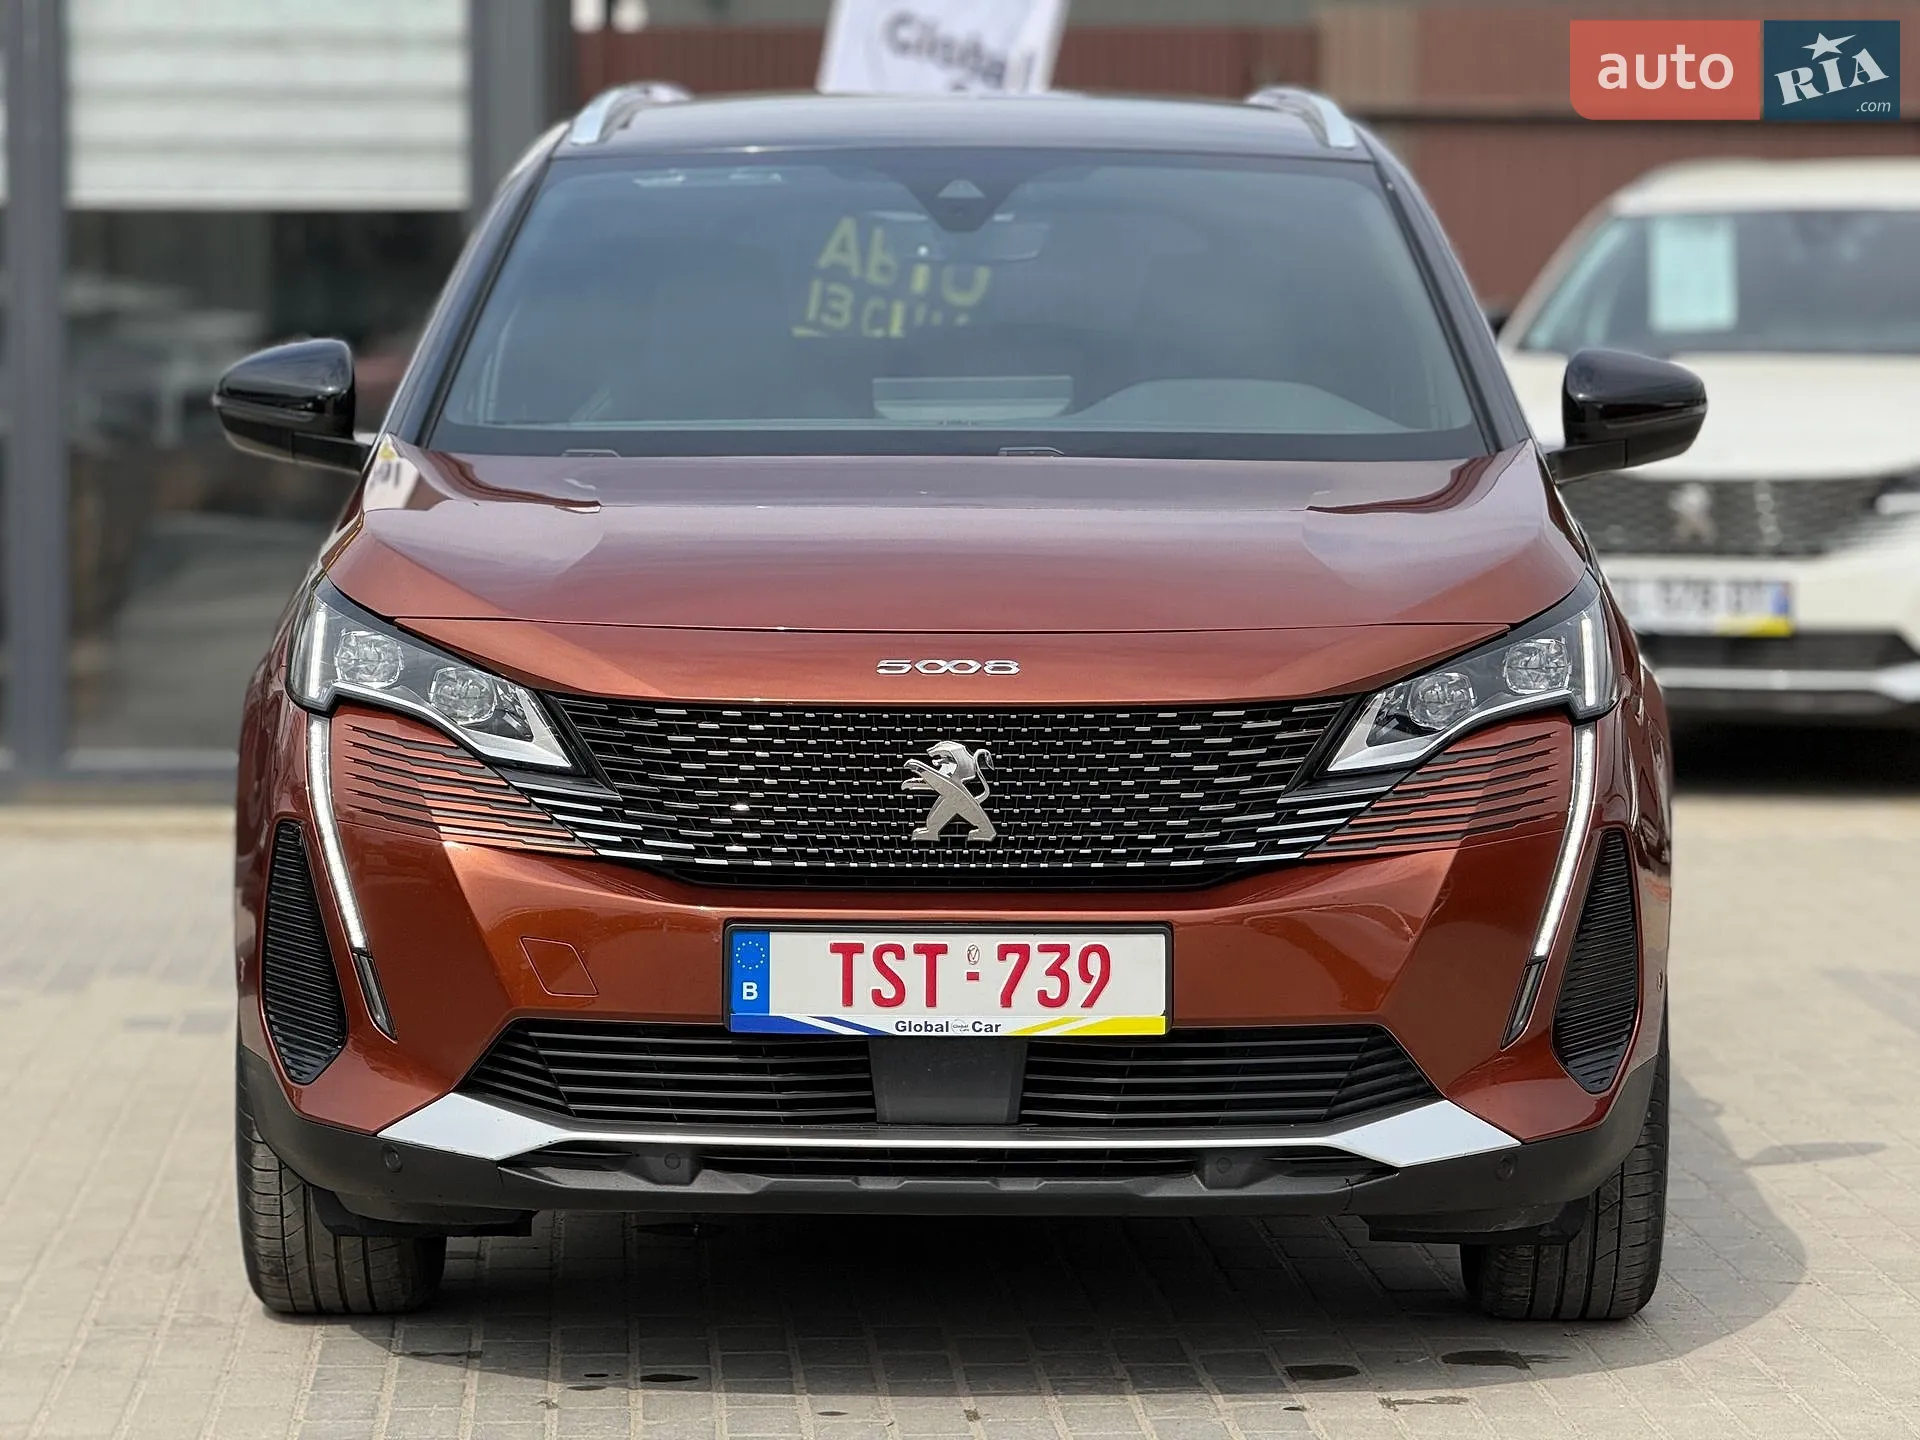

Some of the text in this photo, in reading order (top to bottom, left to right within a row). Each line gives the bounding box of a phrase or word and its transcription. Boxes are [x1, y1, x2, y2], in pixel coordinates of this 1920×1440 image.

[876, 659, 1020, 675] 5008
[742, 982, 758, 1000] B
[895, 1020, 1001, 1033] Global Car
